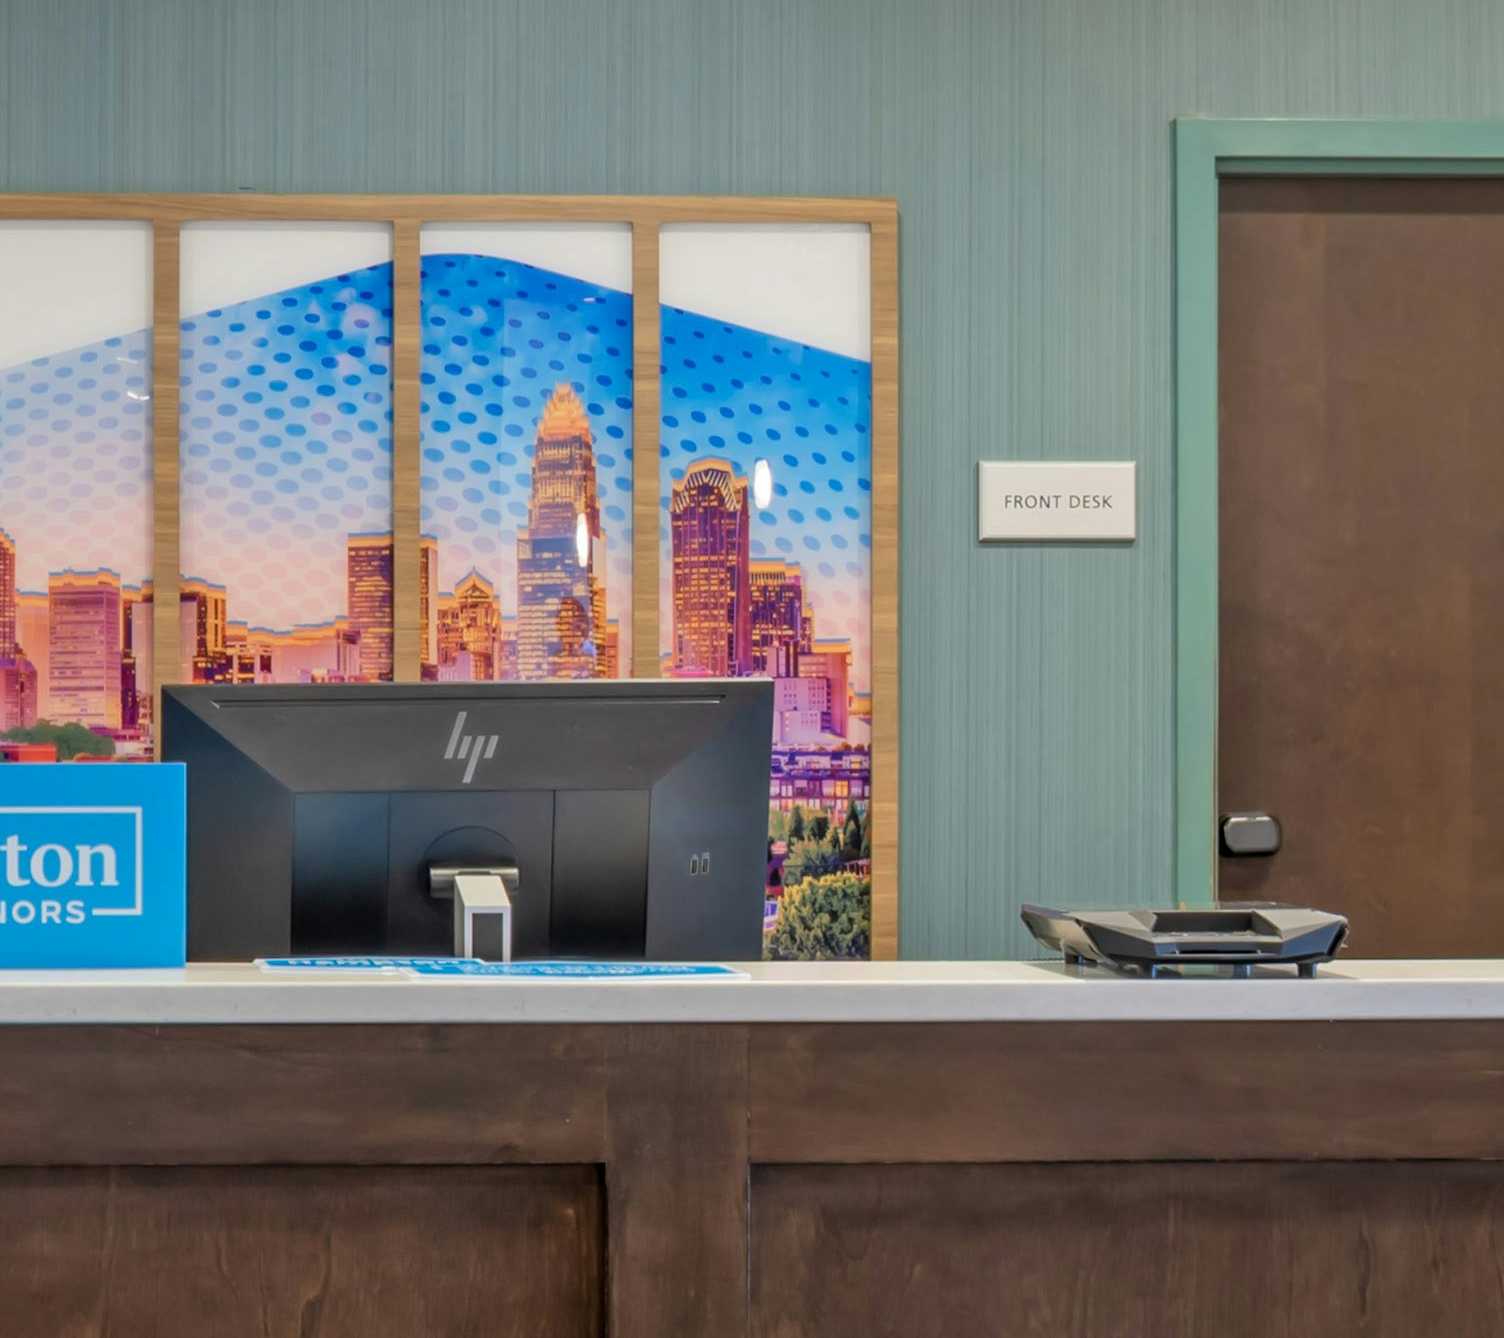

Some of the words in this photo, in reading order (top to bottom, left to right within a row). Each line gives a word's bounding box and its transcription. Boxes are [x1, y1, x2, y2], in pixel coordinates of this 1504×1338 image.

[1004, 495, 1061, 508] FRONT
[1069, 495, 1113, 508] DESK
[443, 711, 500, 784] hp
